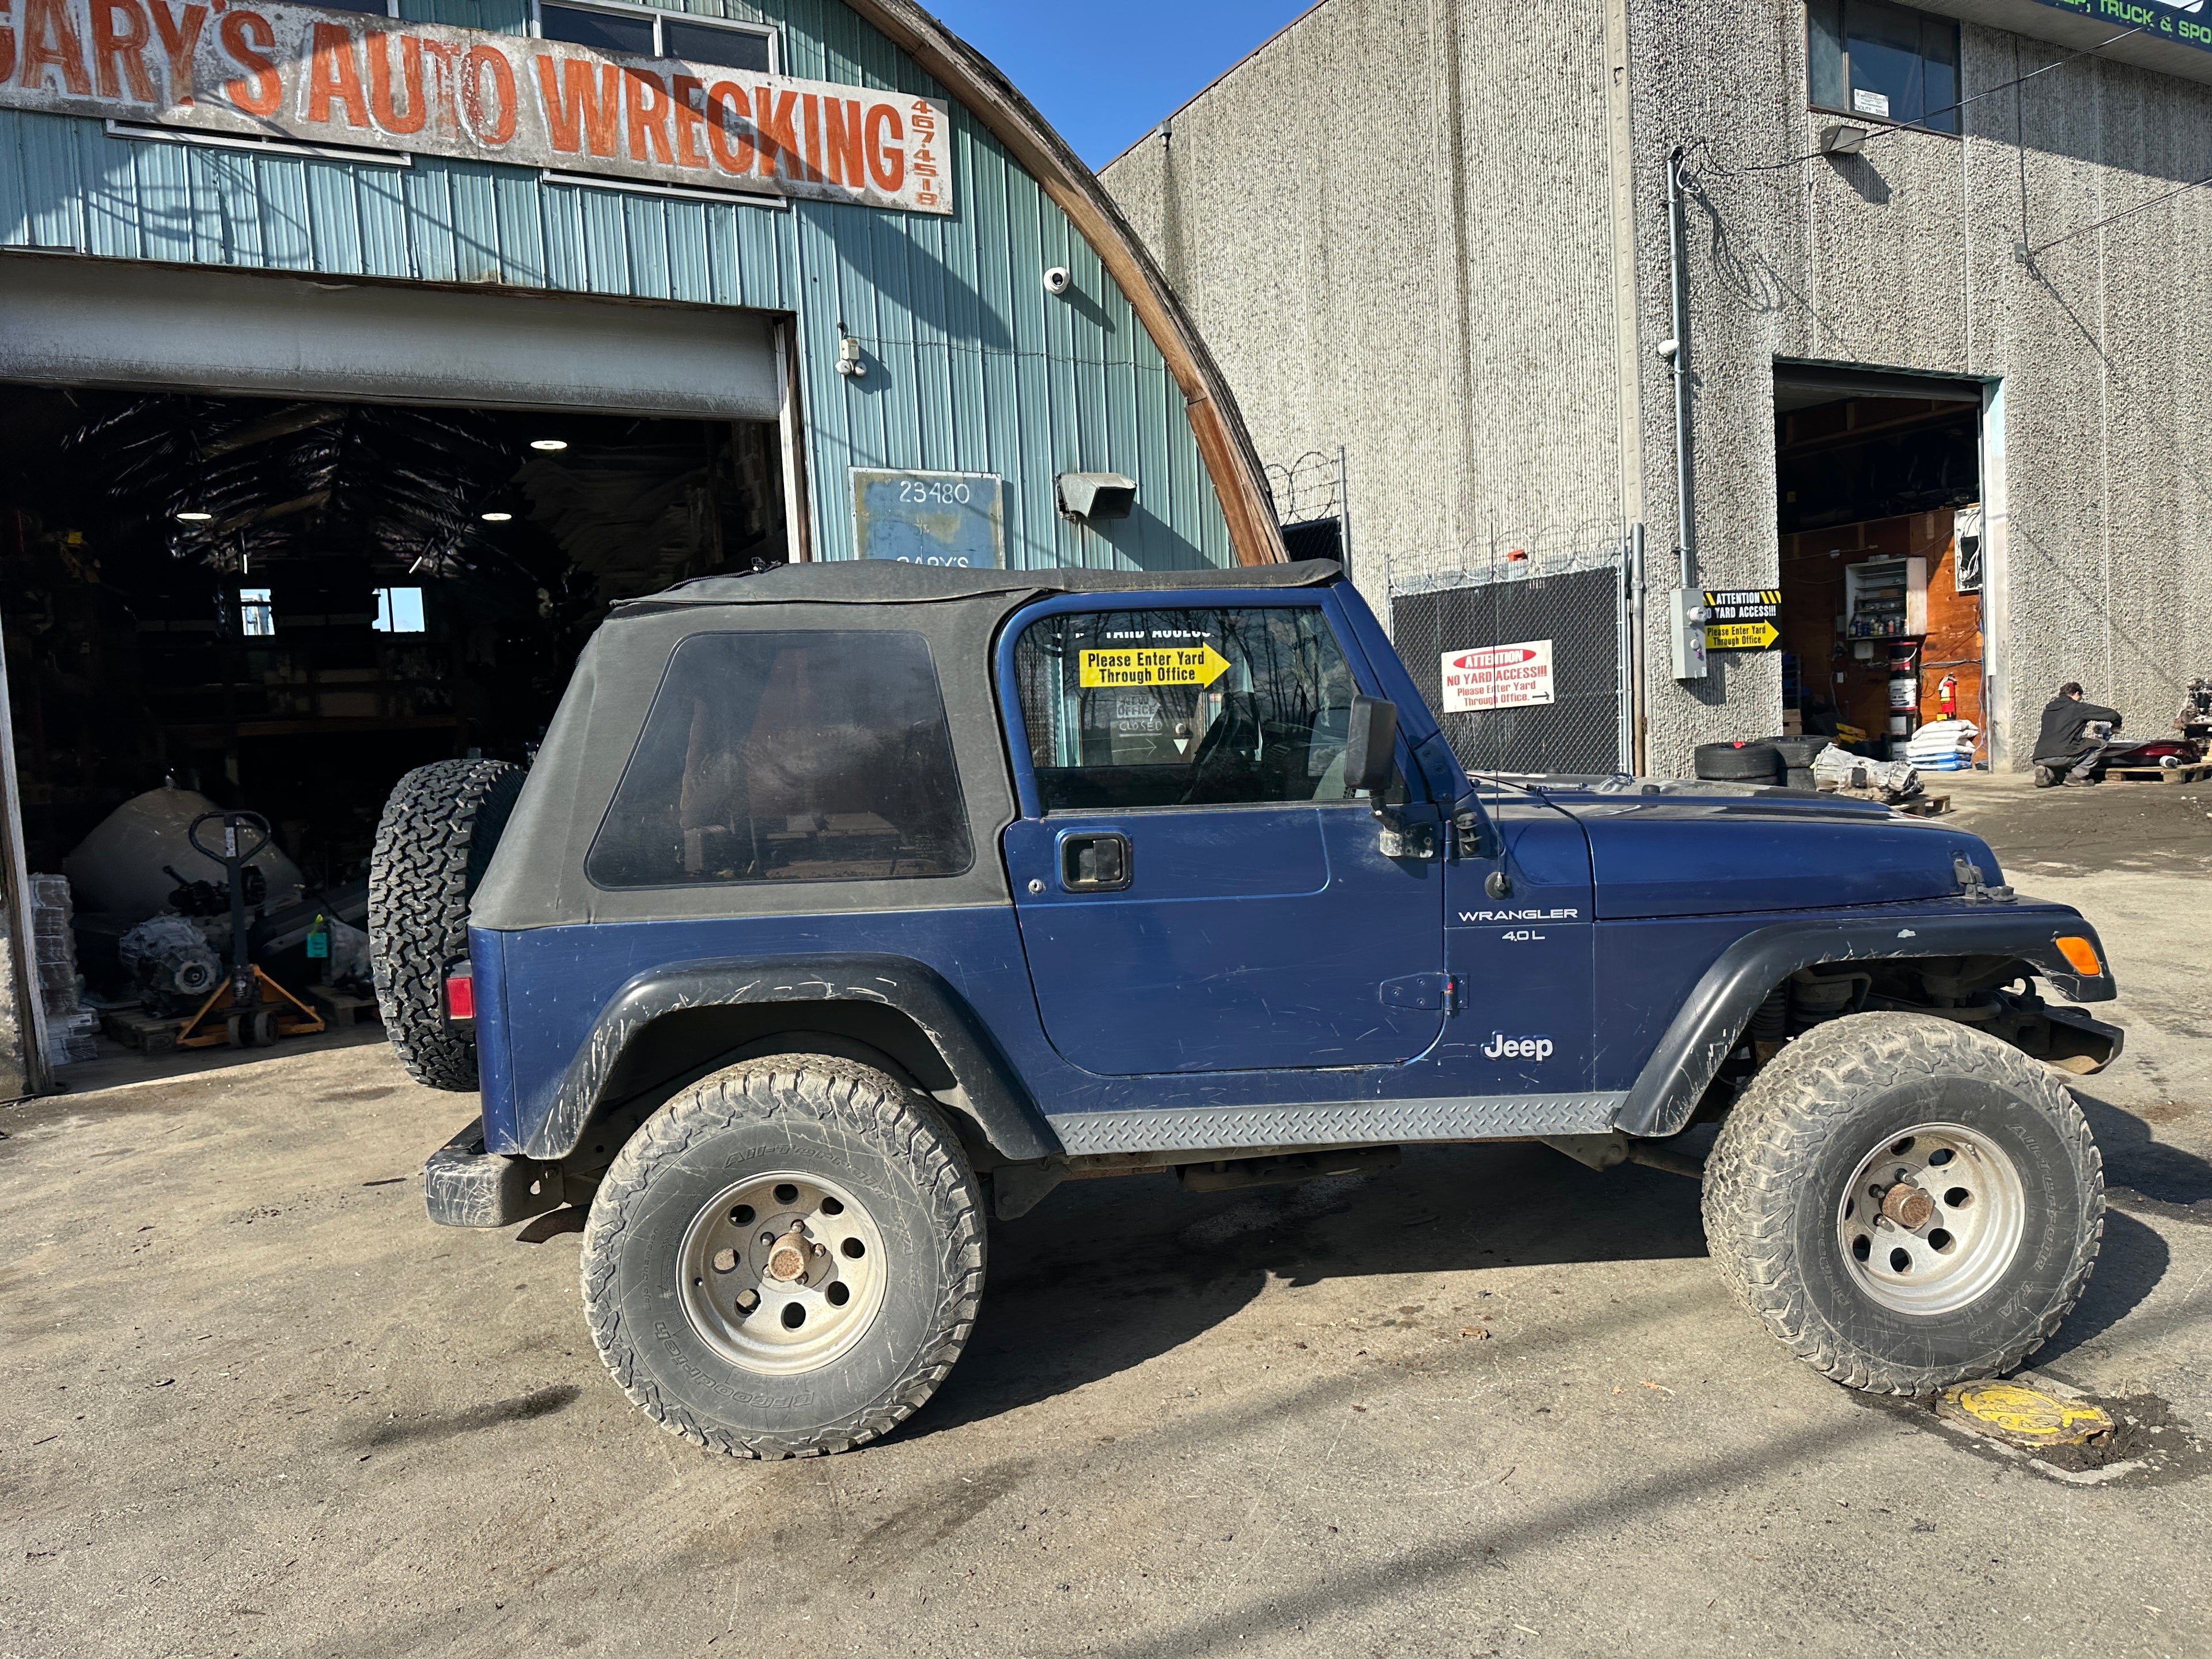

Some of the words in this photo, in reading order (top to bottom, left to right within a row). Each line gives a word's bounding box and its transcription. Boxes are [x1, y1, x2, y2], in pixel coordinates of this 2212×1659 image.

[2100, 0, 2154, 28] TRUCK
[2160, 16, 2173, 32] &
[2178, 20, 2212, 44] SPO
[0, 0, 282, 117] ARY'S
[306, 22, 517, 146] AUTO
[536, 54, 904, 192] WRECKING
[899, 480, 970, 504] 23480
[1716, 592, 1760, 605] ATTENTION
[1715, 607, 1736, 619] YARD
[1738, 605, 1777, 618] ACCESS!!!
[1707, 627, 1729, 637] Please
[1732, 626, 1749, 635] Enter
[1752, 625, 1766, 634] Yard
[1713, 637, 1739, 646] Through
[1742, 635, 1762, 645] Office
[1088, 653, 1131, 667] Please
[1137, 652, 1171, 666] Enter
[1177, 651, 1205, 665] Yard
[1465, 650, 1524, 668] ATTENTION
[1099, 668, 1152, 684] Through
[1158, 667, 1195, 681] Office
[1447, 675, 1460, 687] NO
[1463, 671, 1492, 684] YARD
[1495, 665, 1548, 681] ACCESS!!!
[1457, 687, 1484, 696] Please
[1487, 684, 1510, 694] Enter
[1513, 680, 1536, 691] Yard
[1464, 696, 1498, 707] Through
[1119, 720, 1162, 731] CLOSED
[1459, 908, 1578, 922] WRANGLER
[1484, 1035, 1554, 1061] Jeep
[654, 1321, 815, 1408] BFGoodrich
